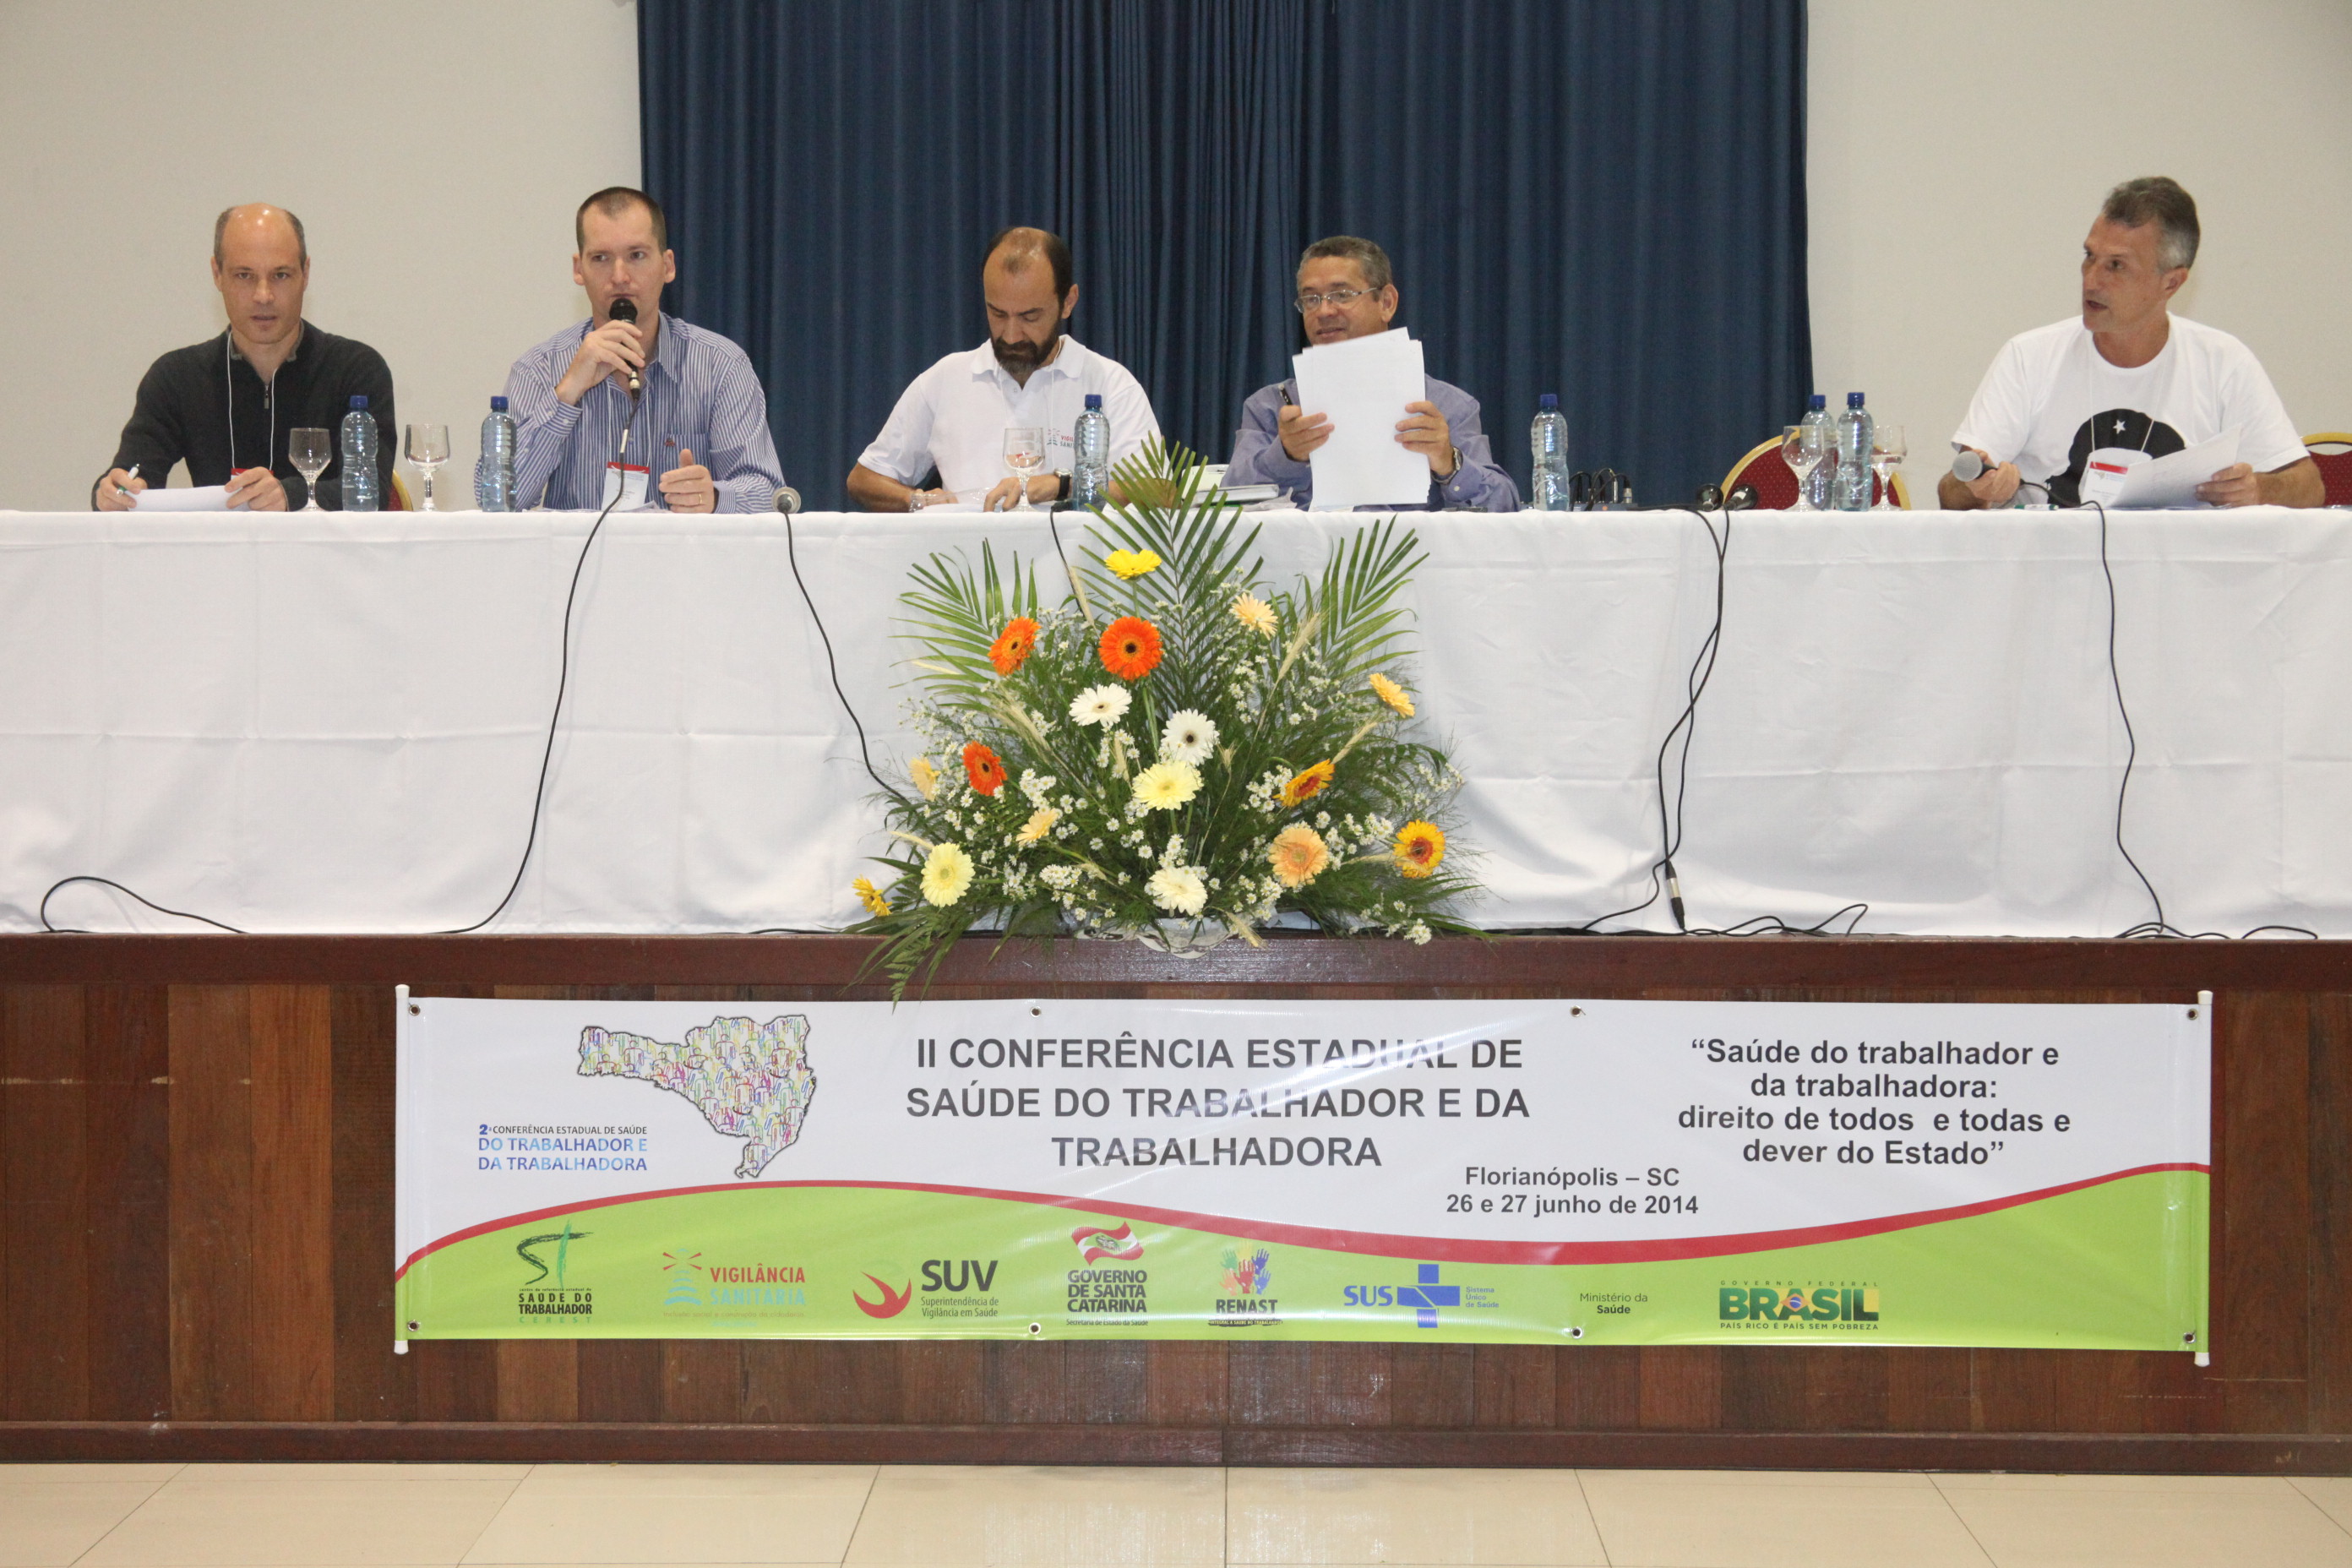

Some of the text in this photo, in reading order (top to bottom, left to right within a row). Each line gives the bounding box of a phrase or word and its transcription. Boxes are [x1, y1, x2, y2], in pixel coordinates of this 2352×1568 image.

[917, 1030, 1522, 1069] II CONFERÊNCIA ESTADUAL DE
[1691, 1037, 2060, 1066] “Saúde do trabalhador e
[1750, 1073, 1996, 1098] da trabalhadora:
[906, 1080, 1531, 1119] SAÚDE DO TRABALHADOR E DA
[1678, 1105, 2071, 1133] direito de todos e todas e
[493, 1124, 554, 1135] CONFERÊNCIA
[556, 1125, 602, 1135] ESTADUAL
[604, 1126, 616, 1135] DE
[618, 1124, 648, 1135] SAÚDE
[478, 1137, 648, 1152] DO TRABALHADOR E
[1051, 1136, 1383, 1167] TRABALHADORA
[1742, 1138, 2005, 1165] dever do Estado”
[478, 1157, 648, 1171] DA TRABALHADORA
[1466, 1166, 1619, 1190] Florianópolis
[1647, 1167, 1680, 1187] SC
[1446, 1194, 1699, 1218] 26 e 27 junho de 2014
[710, 1263, 805, 1283] VIGILÂNCIA
[921, 1259, 999, 1293] SUV
[1067, 1270, 1147, 1283] GOVERNO
[574, 1293, 592, 1303] DO
[710, 1284, 806, 1305] SANITÁRIA
[1068, 1284, 1146, 1298] DE SANTA
[1343, 1285, 1393, 1307] SUS
[1580, 1293, 1648, 1302] Ministério da
[519, 1304, 592, 1315] TRABALHADOR
[921, 1296, 999, 1308] Superintendência de
[1067, 1299, 1147, 1312] CATARINA
[1216, 1298, 1278, 1314] RENAST
[1597, 1304, 1631, 1314] Saúde
[1719, 1288, 1879, 1321] BRASIL
[922, 1308, 959, 1320] Vigilância
[974, 1308, 999, 1317] Saúde
